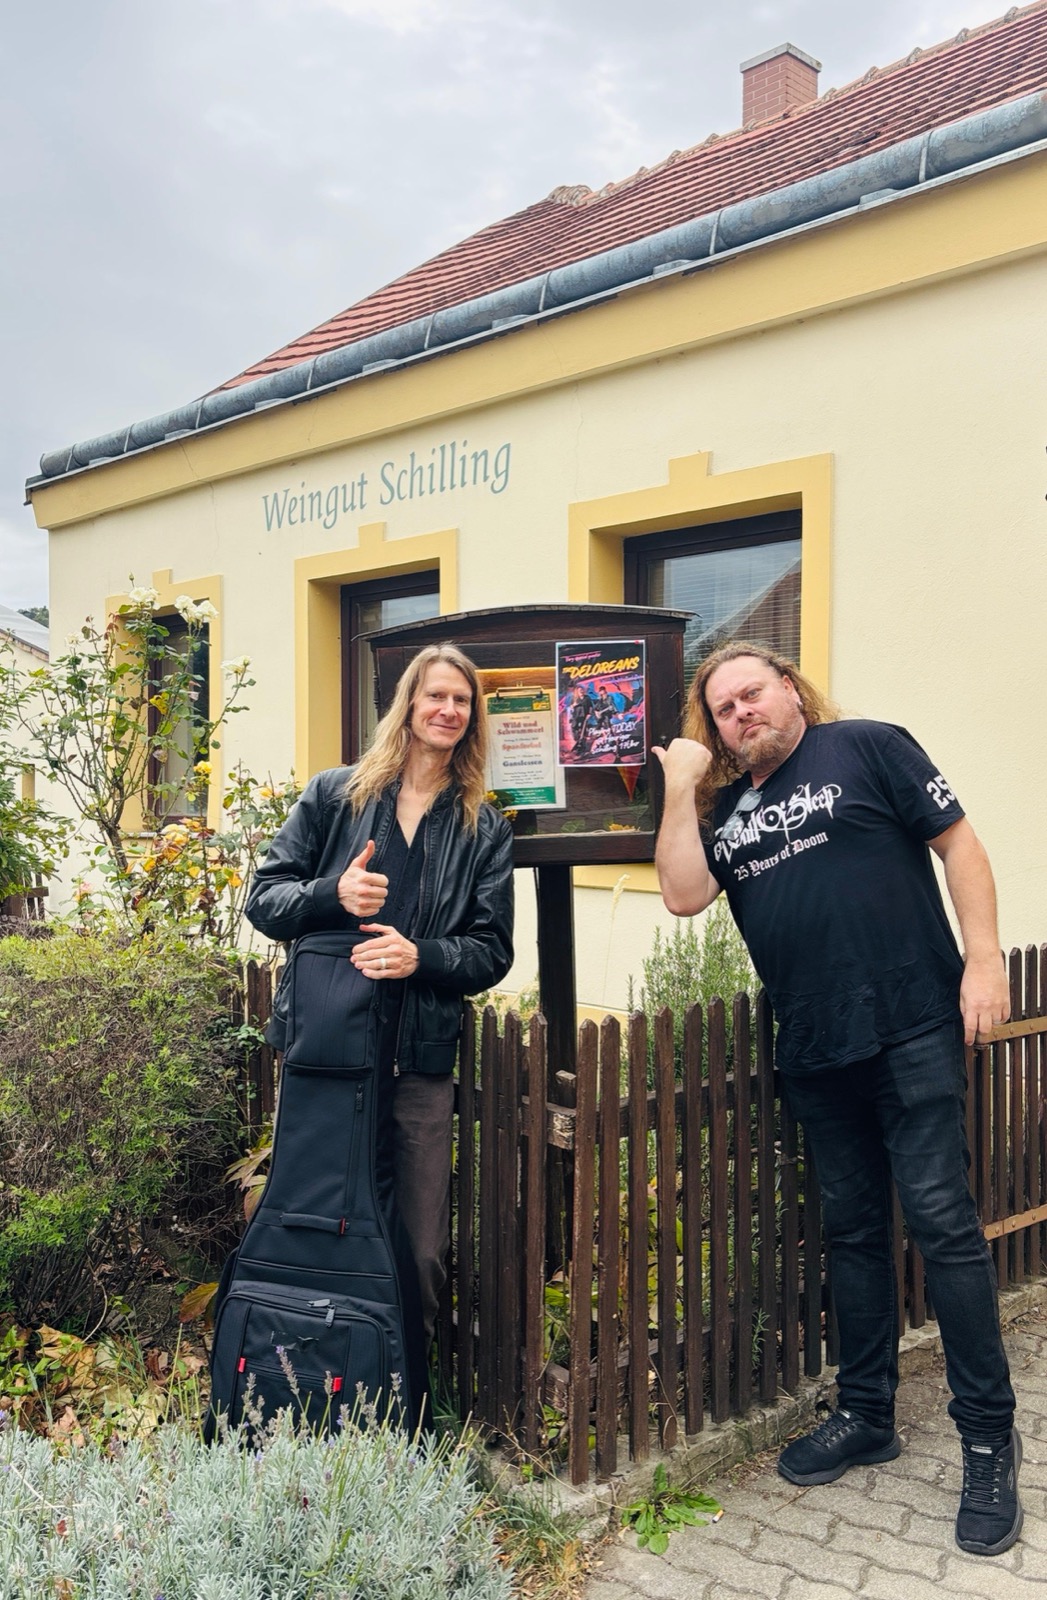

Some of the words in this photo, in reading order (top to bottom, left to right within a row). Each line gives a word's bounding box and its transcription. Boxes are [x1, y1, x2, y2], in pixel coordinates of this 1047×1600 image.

[262, 472, 368, 532] Weingut
[379, 440, 511, 506] Schilling
[570, 656, 640, 679] DELOREANS
[523, 720, 538, 728] und
[612, 721, 638, 733] TODAY
[786, 782, 842, 826] Sleep
[926, 775, 955, 810] 25
[733, 865, 749, 881] 25
[748, 853, 779, 877] Years
[780, 844, 791, 860] of
[790, 831, 829, 855] Doom
